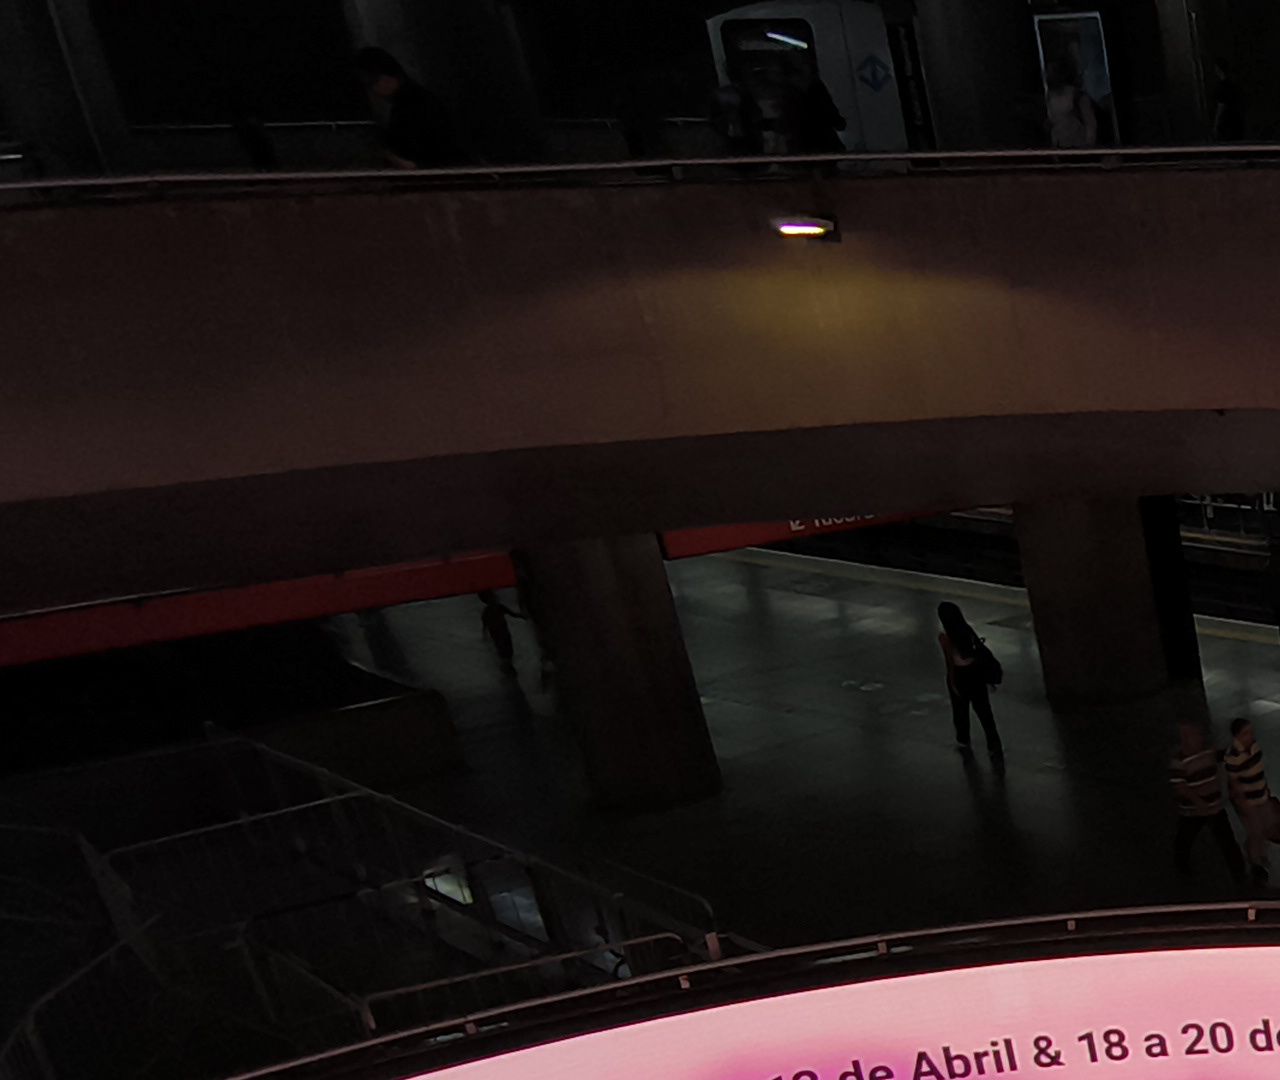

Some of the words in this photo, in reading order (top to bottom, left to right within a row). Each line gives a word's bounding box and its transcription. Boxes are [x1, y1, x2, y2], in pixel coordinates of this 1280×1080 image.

[1032, 1035, 1066, 1069] &
[1077, 1028, 1130, 1063] 18
[1143, 1031, 1169, 1058] a
[1181, 1021, 1236, 1056] 20
